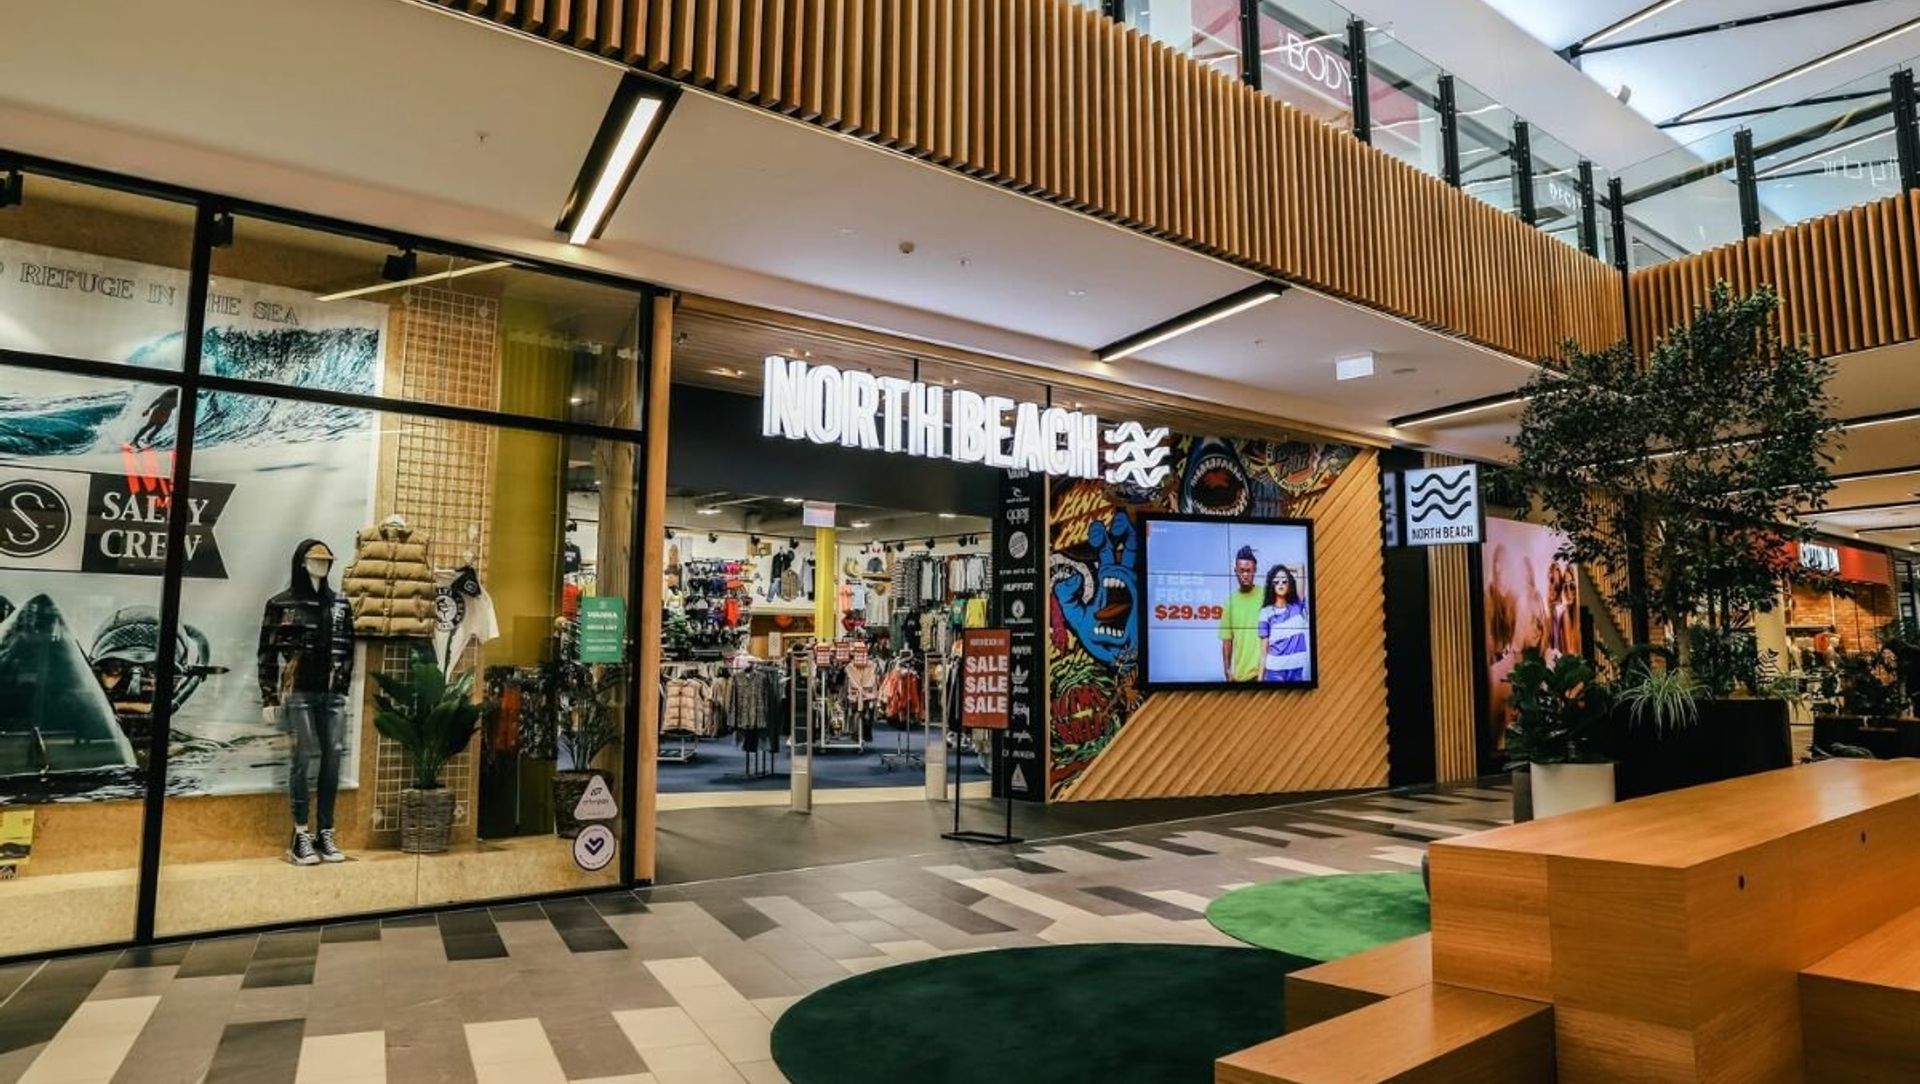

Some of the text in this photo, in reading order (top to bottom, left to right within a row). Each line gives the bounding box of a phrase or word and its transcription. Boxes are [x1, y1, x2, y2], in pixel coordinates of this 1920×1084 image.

[20, 262, 135, 300] REFUGE
[149, 284, 176, 306] IN
[206, 292, 242, 316] HE
[252, 300, 300, 325] SEA
[762, 355, 1100, 479] NORTH BEACH
[102, 491, 209, 526] SALY
[1412, 525, 1473, 540] NORTH BEACH
[1155, 604, 1224, 621] $29.99
[965, 655, 1008, 673] SALE
[965, 675, 1008, 694] SALE
[964, 695, 1008, 713] SALE
